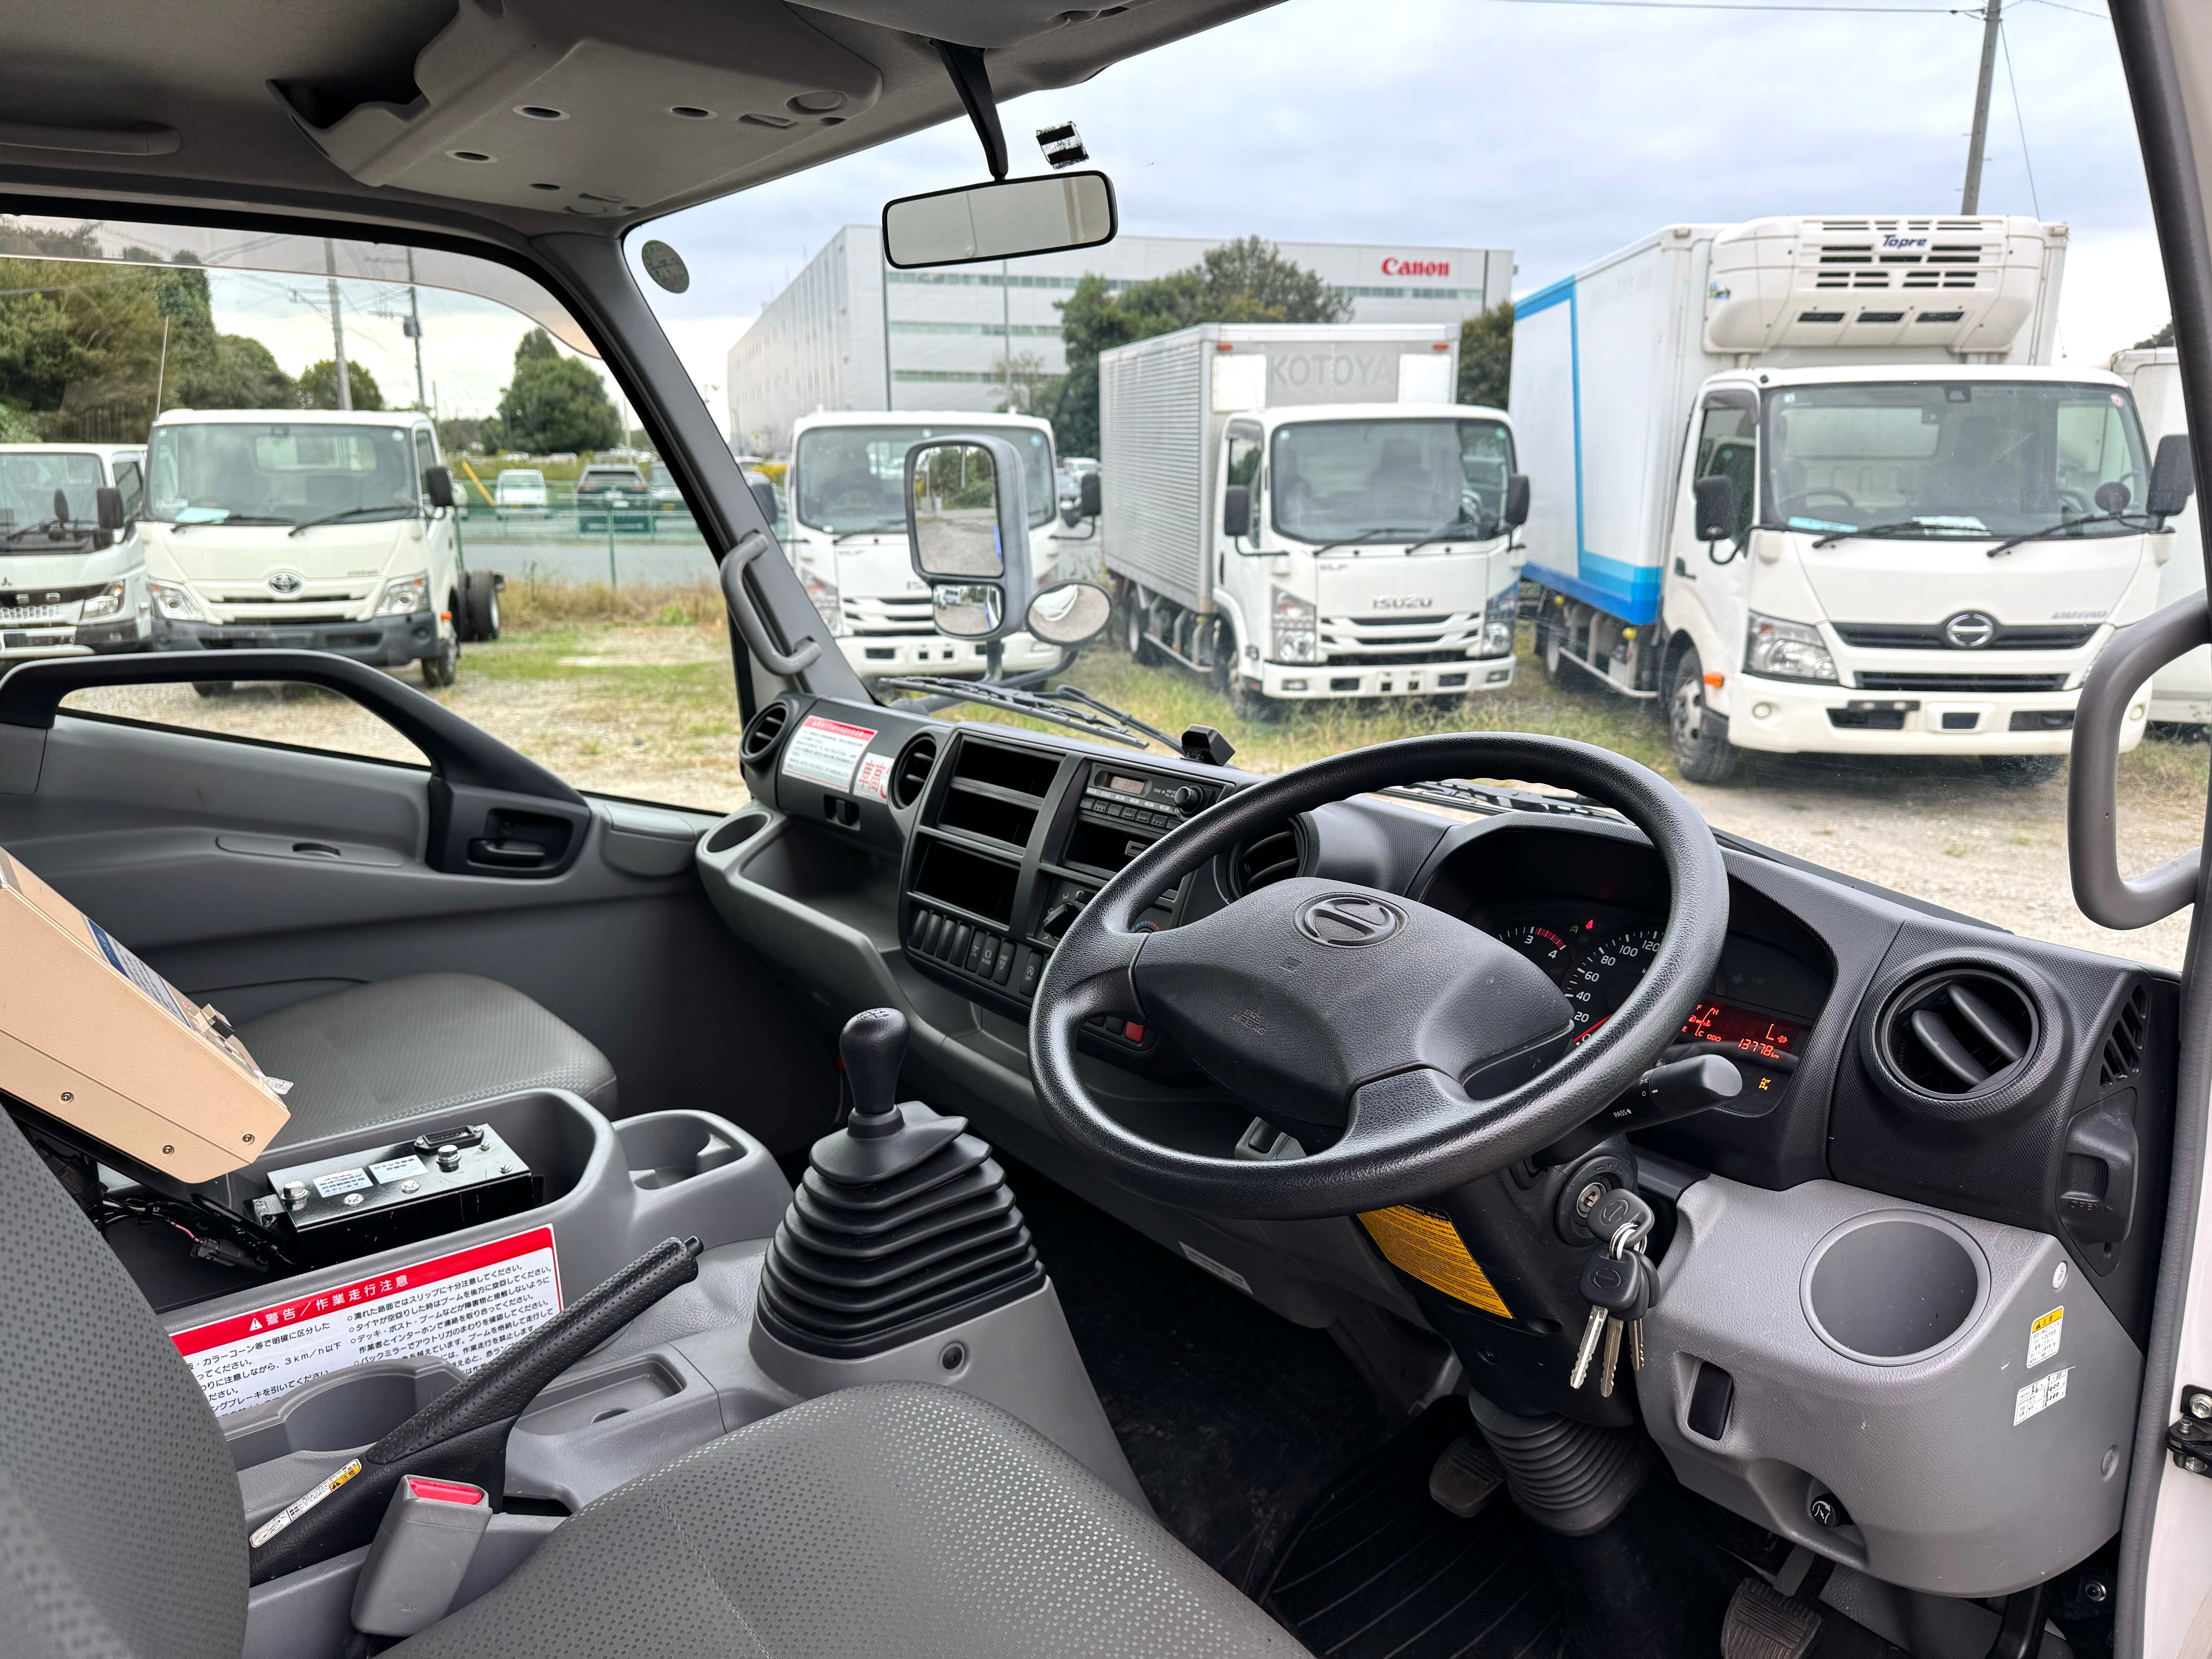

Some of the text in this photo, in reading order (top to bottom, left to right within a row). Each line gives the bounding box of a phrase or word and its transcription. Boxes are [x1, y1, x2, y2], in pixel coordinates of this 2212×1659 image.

[1884, 234, 1927, 249] Topre
[1382, 257, 1449, 276] Canon
[1270, 354, 1393, 386] KOTOYA
[1373, 596, 1433, 610] ISUZU
[1525, 935, 1533, 944] 3
[1642, 940, 1660, 952] 120
[1548, 950, 1558, 958] 4
[1619, 945, 1638, 957] 100
[1601, 955, 1616, 966] 80
[1585, 971, 1600, 982] 60
[1576, 991, 1591, 1002] 40
[1244, 1008, 1264, 1022] SRS
[1574, 1011, 1589, 1023] 20
[1228, 1015, 1266, 1035] AIRBAG
[1706, 1034, 1722, 1043] ODO
[1738, 1038, 1774, 1057] 13778
[1613, 1109, 1628, 1118] PASS
[1607, 1162, 1623, 1175] PUSH
[196, 1359, 252, 1381] ってください。
[208, 1388, 239, 1402] ださい。
[341, 1469, 356, 1482] 注意
